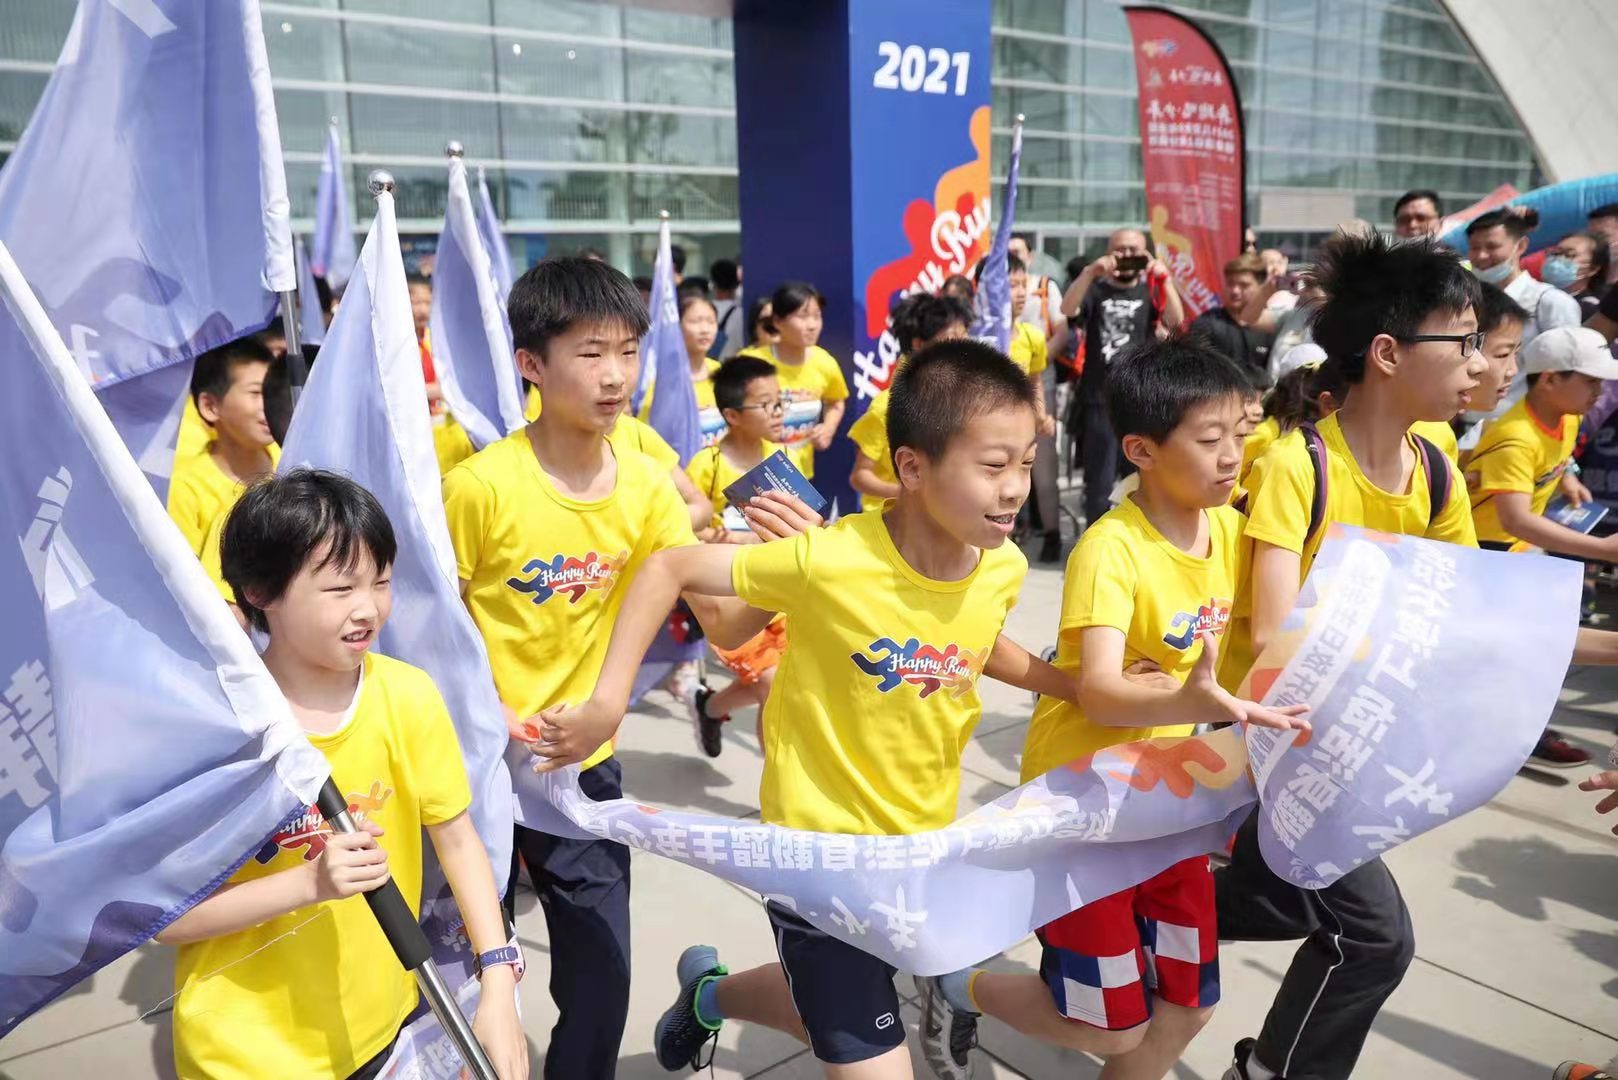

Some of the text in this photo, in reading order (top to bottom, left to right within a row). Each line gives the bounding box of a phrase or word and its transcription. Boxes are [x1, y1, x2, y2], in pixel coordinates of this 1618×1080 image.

[873, 40, 970, 96] 2021
[539, 562, 613, 587] Happy Run
[887, 653, 971, 678] Happy Run
